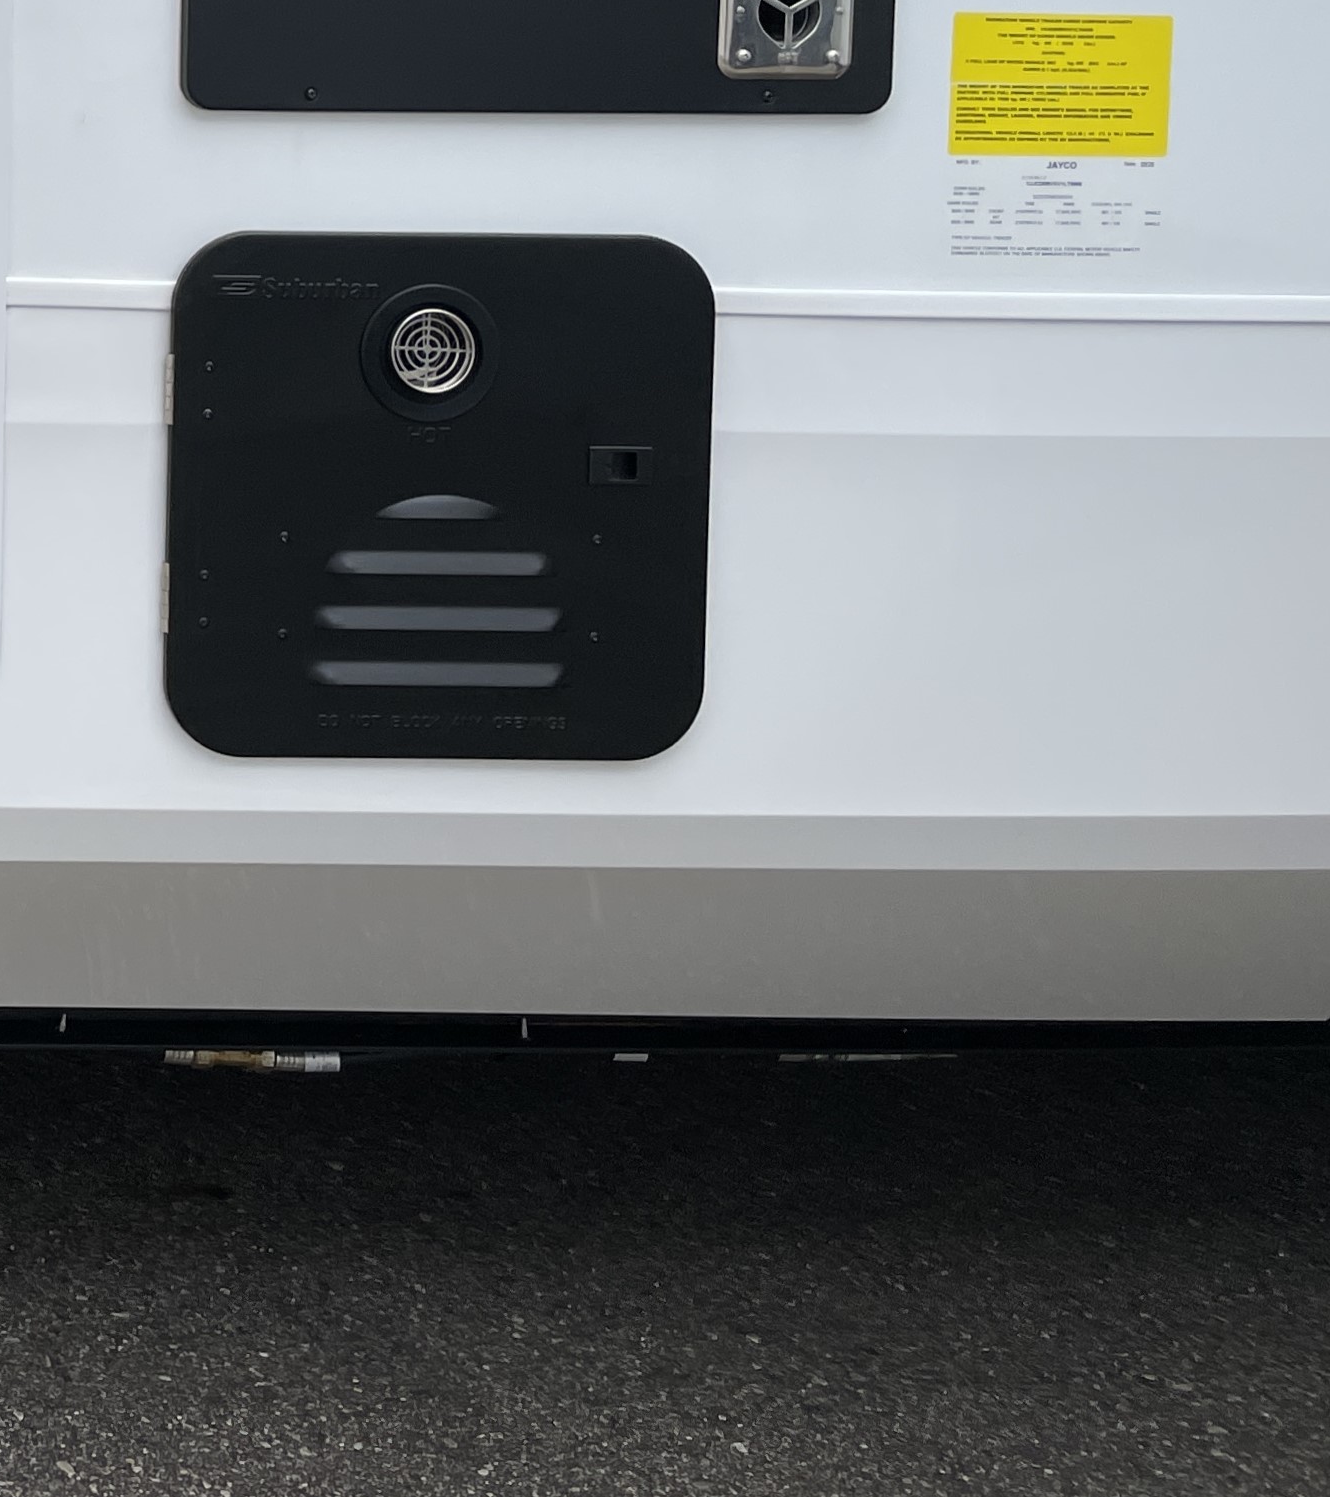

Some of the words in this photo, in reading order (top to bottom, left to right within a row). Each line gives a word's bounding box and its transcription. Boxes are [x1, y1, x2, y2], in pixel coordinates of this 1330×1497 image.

[1046, 160, 1077, 170] JAYCO
[261, 276, 380, 299] Suburban
[407, 425, 452, 444] HOT
